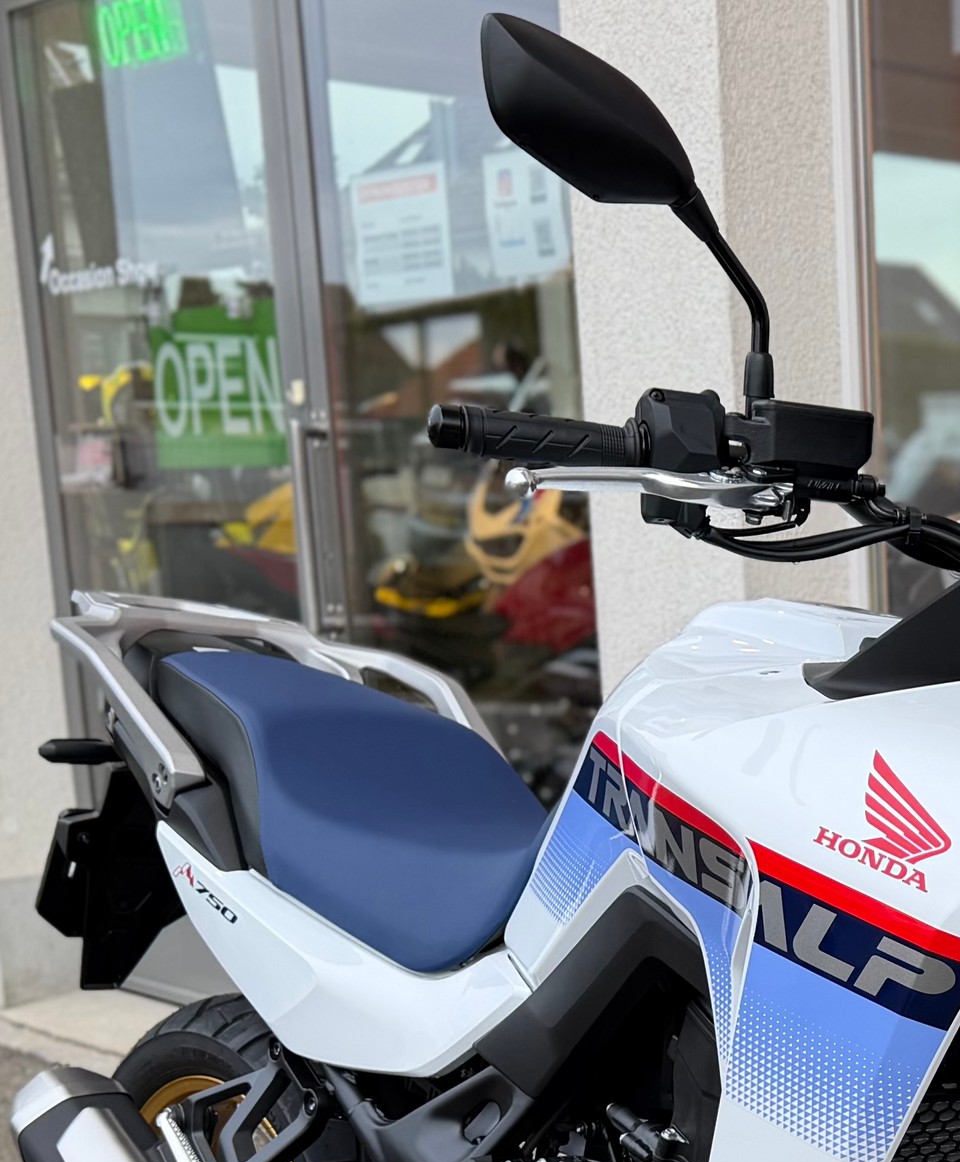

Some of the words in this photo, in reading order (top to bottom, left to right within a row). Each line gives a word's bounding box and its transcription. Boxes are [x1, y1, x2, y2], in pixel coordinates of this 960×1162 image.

[98, 0, 180, 67] OPEN
[155, 339, 286, 437] OPEN
[812, 826, 928, 893] HONDA
[195, 880, 238, 924] 750
